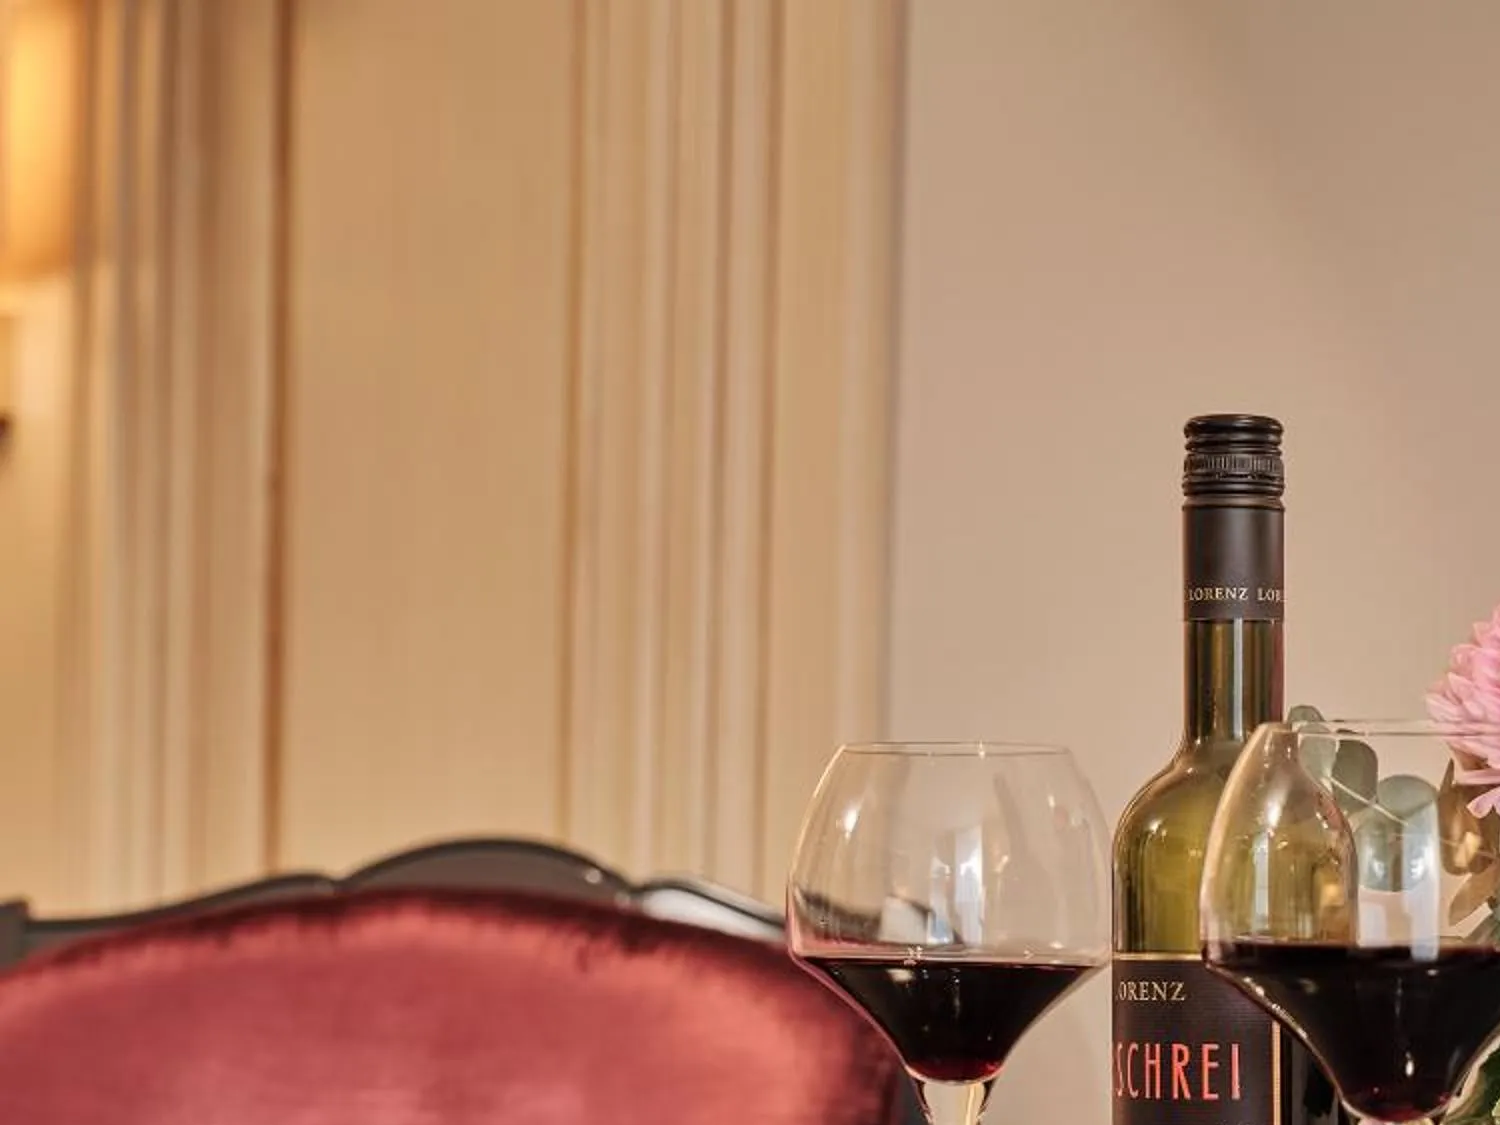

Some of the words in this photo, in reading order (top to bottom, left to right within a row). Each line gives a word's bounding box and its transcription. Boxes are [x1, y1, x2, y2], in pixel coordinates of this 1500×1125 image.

[1189, 586, 1249, 602] LORENZ
[1115, 981, 1185, 1001] ORENZ
[1114, 1042, 1242, 1101] SCHREI
